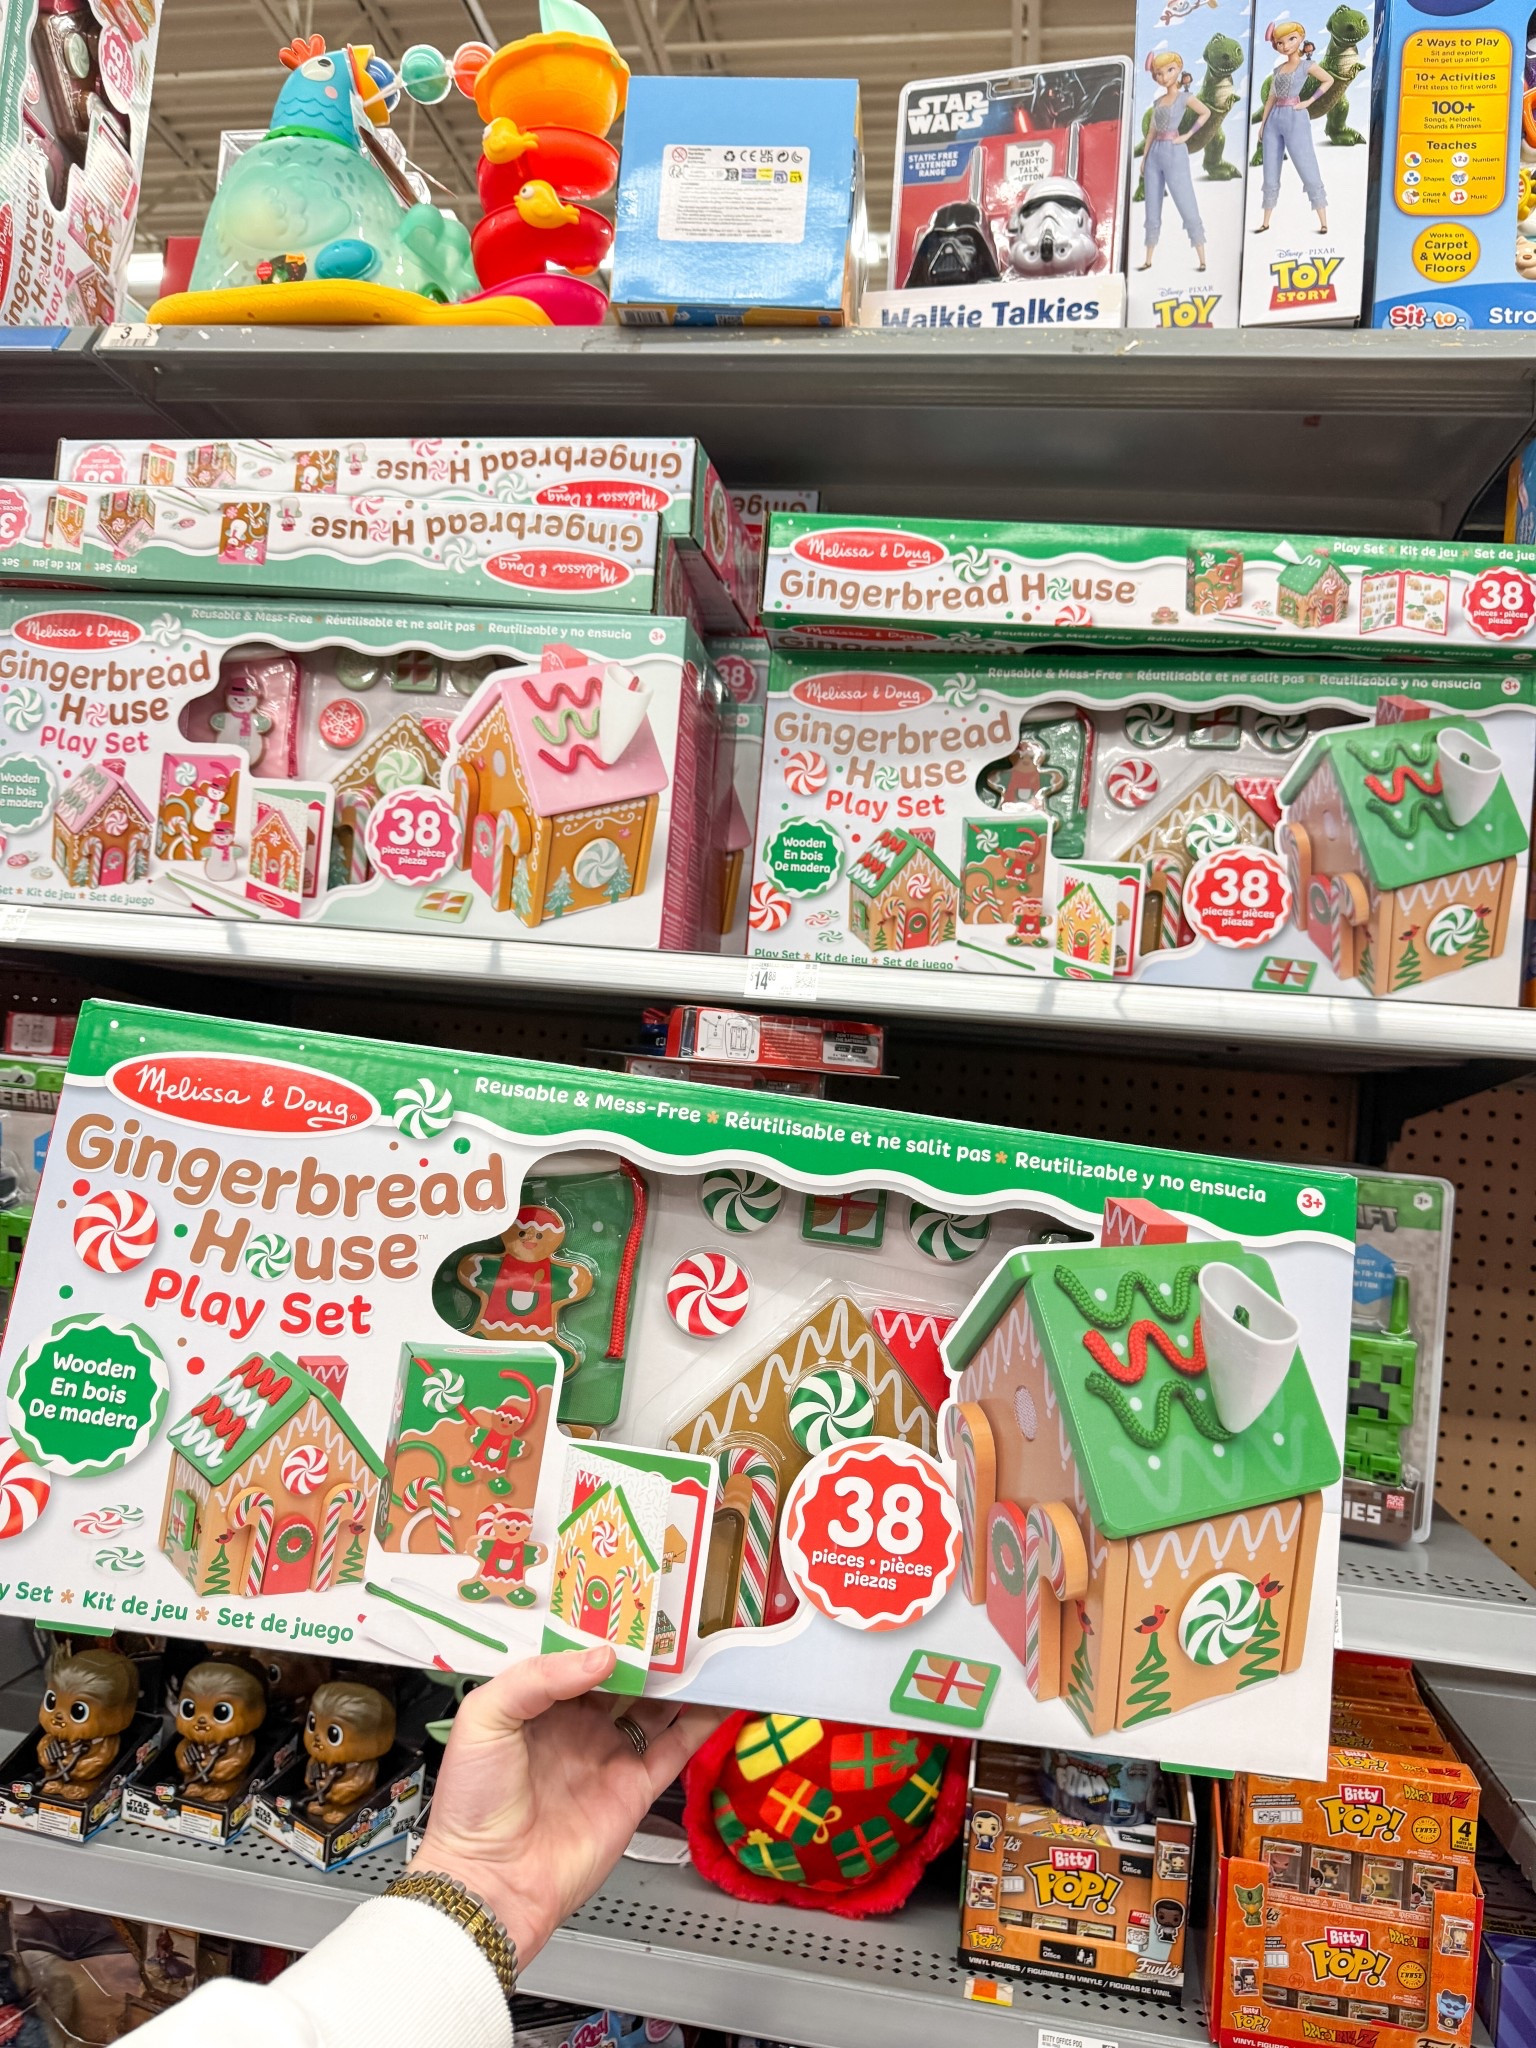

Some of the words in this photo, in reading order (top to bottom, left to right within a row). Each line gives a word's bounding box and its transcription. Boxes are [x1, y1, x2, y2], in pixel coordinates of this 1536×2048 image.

[1427, 39, 1456, 48] Ways
[1476, 38, 1500, 47] Play
[1416, 73, 1436, 81] 10+
[1440, 72, 1496, 82] Activities
[908, 90, 989, 115] STAR
[1431, 100, 1475, 115] 100+
[908, 108, 988, 135] WARS
[1019, 149, 1040, 158] EASY
[1426, 140, 1477, 150] Teaches
[908, 153, 936, 163] STATIC
[937, 151, 959, 160] FREE
[915, 160, 957, 171] EXTENDED
[1010, 159, 1049, 167] PUSH-TO-
[918, 169, 946, 177] RANGE
[1014, 173, 1044, 183] UTTON
[1019, 166, 1039, 174] TALK
[1424, 240, 1469, 251] Carpet
[1429, 231, 1453, 239] Works
[1308, 247, 1336, 255] PIXAR
[1420, 252, 1428, 261] &
[1433, 251, 1472, 262] Wood
[1270, 257, 1345, 291] TOY
[1424, 263, 1466, 273] Floors
[1276, 289, 1330, 303] STORY
[881, 304, 982, 328] Walkie
[991, 297, 1099, 326] Talkies
[1153, 295, 1222, 328] TOY
[480, 444, 682, 481] Gingerbread
[426, 511, 643, 553] Gingerbread
[807, 538, 874, 561] Melissa
[893, 542, 932, 568] Doug
[1333, 541, 1361, 556] Play
[1363, 543, 1384, 554] Set
[1400, 545, 1418, 556] Kit
[1420, 546, 1436, 557] de
[1437, 547, 1458, 559] jeu
[1474, 549, 1495, 559] Set
[1498, 549, 1513, 560] de
[499, 554, 535, 578] Doug
[552, 561, 618, 586] Melissa
[780, 569, 1009, 611] Gingerbread
[1479, 579, 1524, 611] 38
[1473, 609, 1498, 618] pieces
[0, 649, 211, 692] Gingerbread
[805, 681, 868, 703] Melissa
[885, 684, 921, 708] Doug
[40, 726, 100, 759] Play
[105, 732, 149, 753] Set
[774, 710, 1012, 755] Gingerbread
[825, 789, 888, 823] Play
[897, 795, 945, 818] Set
[388, 808, 441, 848] 38
[783, 837, 826, 849] Wooden
[784, 850, 799, 860] En
[800, 850, 823, 861] bois
[774, 861, 789, 872] De
[790, 862, 831, 874] madera
[1210, 867, 1269, 908] 38
[1202, 906, 1234, 918] pieces
[1242, 907, 1275, 919] pièces
[1221, 917, 1254, 928] piezas
[136, 1064, 251, 1104] Melissa
[262, 1085, 275, 1107] &
[284, 1085, 349, 1128] Doug
[475, 1076, 568, 1104] Reusable
[573, 1090, 591, 1108] &
[595, 1093, 701, 1123] Mess-Free
[725, 1110, 846, 1142] Réutilisable
[850, 1130, 873, 1147] et
[876, 1134, 901, 1150] ne
[905, 1137, 951, 1159] salit
[956, 1143, 992, 1164] pas
[1015, 1151, 1138, 1183] Reutilizable
[1142, 1172, 1156, 1189] y
[1160, 1173, 1184, 1191] no
[1190, 1177, 1267, 1204] ensucia
[1301, 1193, 1323, 1210] 3+
[66, 1113, 505, 1218] Gingerbread
[144, 1269, 266, 1338] Play
[280, 1293, 373, 1335] Set
[52, 1351, 136, 1380] Wooden
[50, 1377, 78, 1398] En
[81, 1380, 127, 1404] bois
[29, 1398, 57, 1420] De
[59, 1401, 138, 1431] madera
[827, 1476, 924, 1555] 38
[811, 1548, 865, 1568] pieces
[880, 1556, 933, 1578] pièces
[844, 1571, 897, 1591] piezas
[15, 1582, 53, 1603] Set
[82, 1589, 115, 1610] Kit
[121, 1593, 148, 1615] de
[150, 1599, 188, 1623] jeu
[217, 1607, 256, 1629] Set
[261, 1611, 287, 1633] de
[290, 1615, 354, 1645] juego
[1344, 1788, 1379, 1802] Bitty
[1319, 1799, 1405, 1841] POP!
[1458, 1821, 1471, 1838] 4
[1054, 1851, 1094, 1869] Bitty
[1122, 1865, 1142, 1875] Office
[1028, 1862, 1121, 1913] POP!
[1330, 1930, 1365, 1945] Bitty
[1136, 1957, 1180, 1978] Funko
[1303, 1941, 1392, 1986] POP!
[968, 1956, 990, 1967] VINYL
[991, 1959, 1021, 1972] FIGURES
[1027, 1967, 1064, 1981] FIGURINES
[1066, 1973, 1076, 1981] EN
[1077, 1974, 1103, 1987] VINYLE
[1109, 1981, 1140, 1993] FIGURAS
[1141, 1985, 1151, 1994] DE
[1152, 1987, 1172, 1998] VINIL
[1232, 2011, 1269, 2031] POP!
[1243, 2006, 1259, 2015] Bitty
[1056, 2036, 1073, 2047] OFFICE
